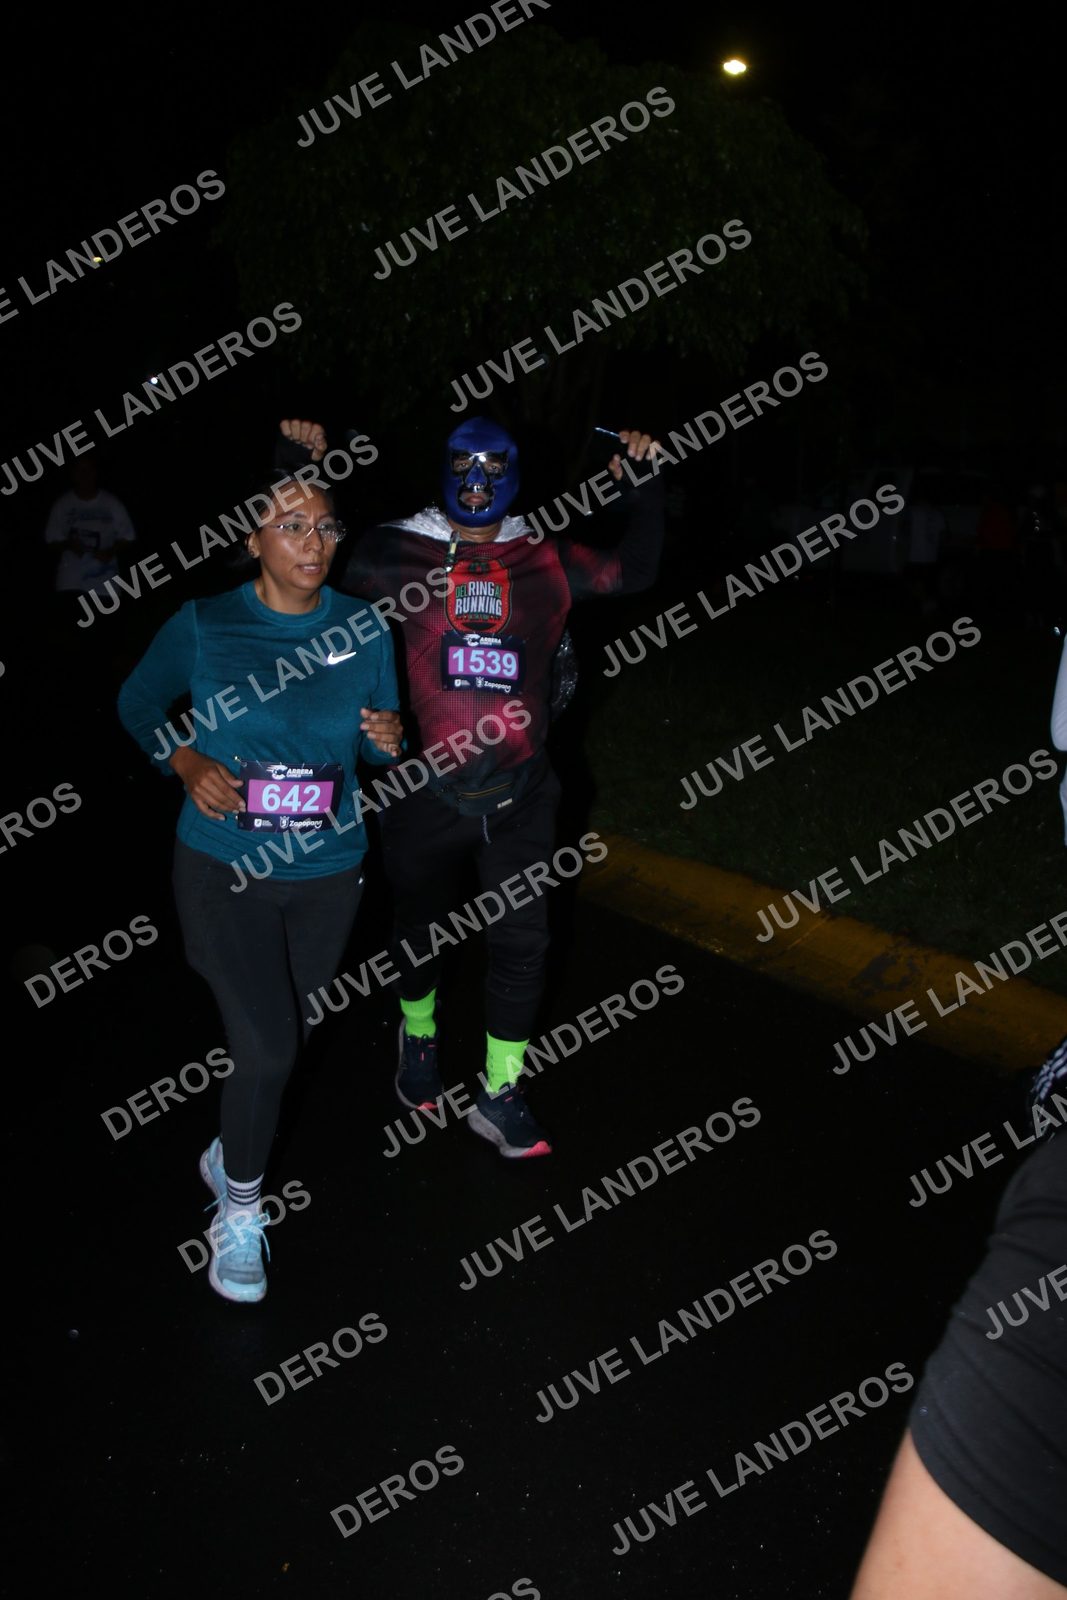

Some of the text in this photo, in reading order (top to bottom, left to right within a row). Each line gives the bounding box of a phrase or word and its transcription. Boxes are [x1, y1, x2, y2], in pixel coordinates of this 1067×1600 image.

[469, 581, 495, 596] RING
[455, 596, 502, 616] RUNNING
[452, 648, 517, 677] 1539
[261, 783, 321, 812] 642
